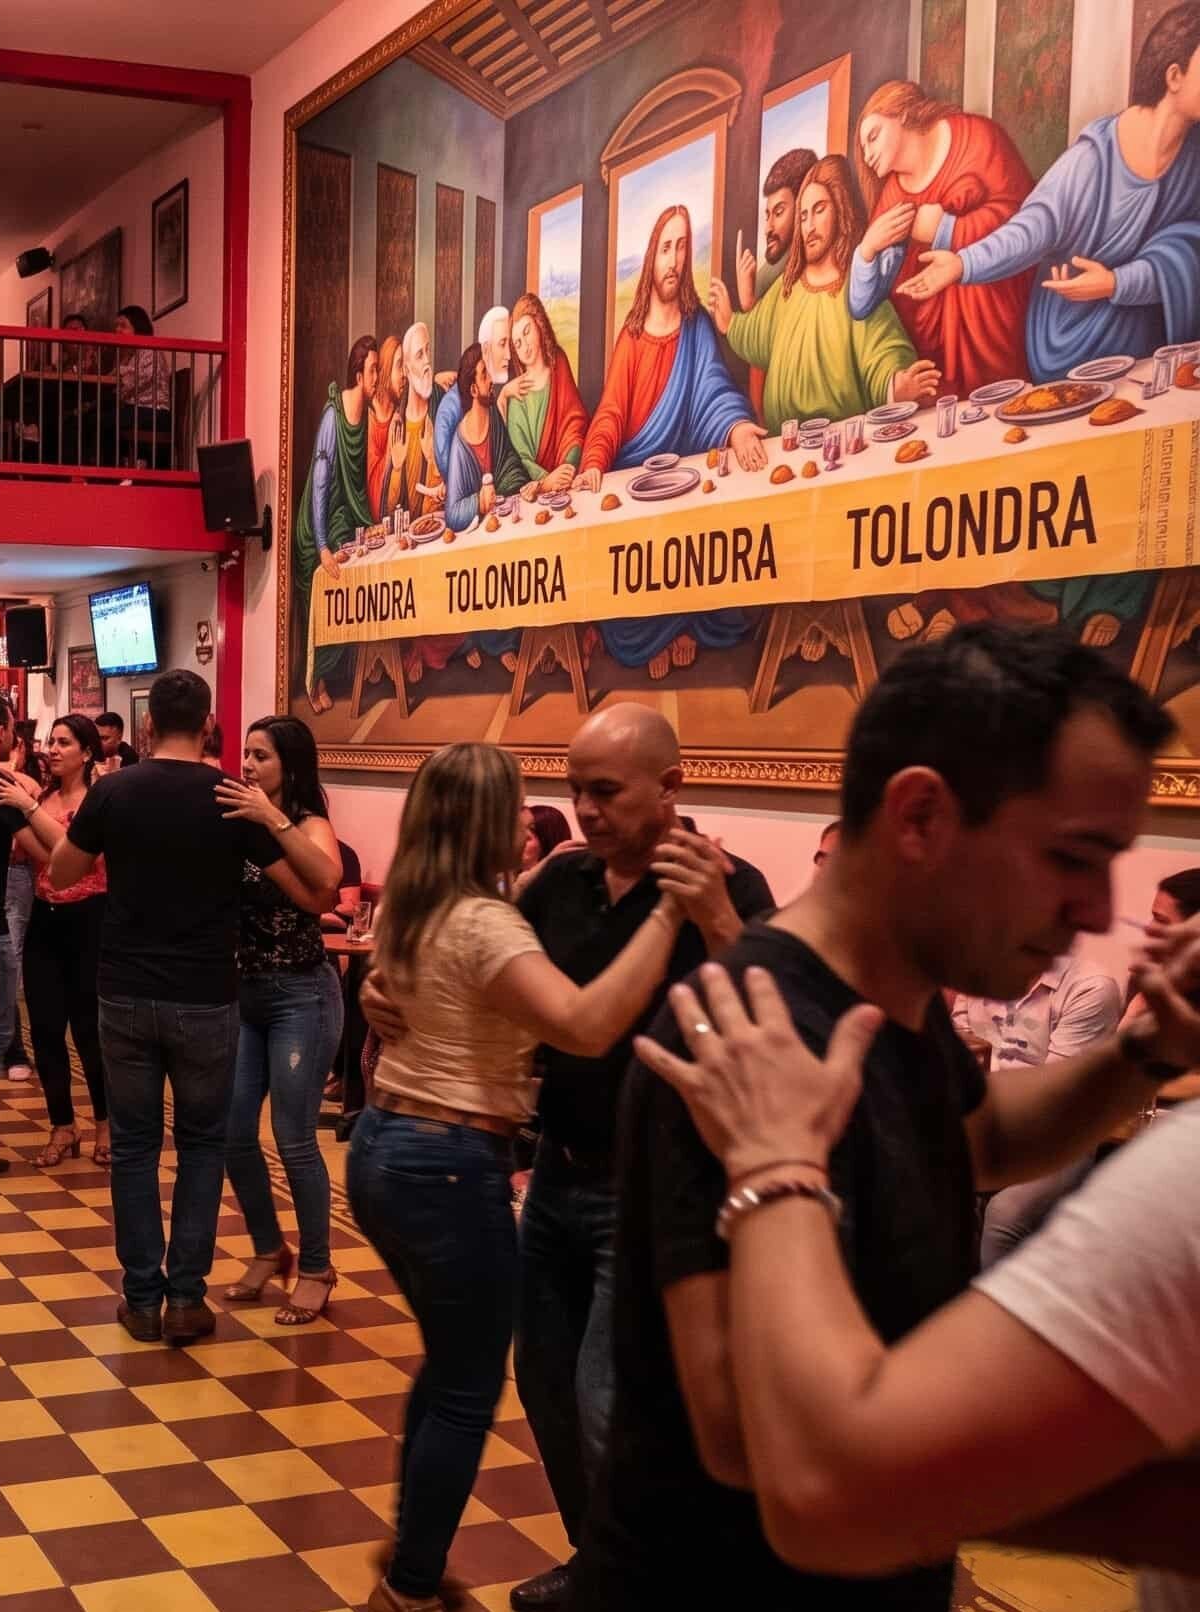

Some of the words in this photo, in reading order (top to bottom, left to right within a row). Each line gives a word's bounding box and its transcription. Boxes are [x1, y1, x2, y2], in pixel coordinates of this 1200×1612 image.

[324, 577, 417, 627] TOLONDRA
[445, 555, 567, 614] TOLONDRA
[608, 523, 778, 596] TOLONDRA
[846, 475, 1097, 571] TOLONDRA
